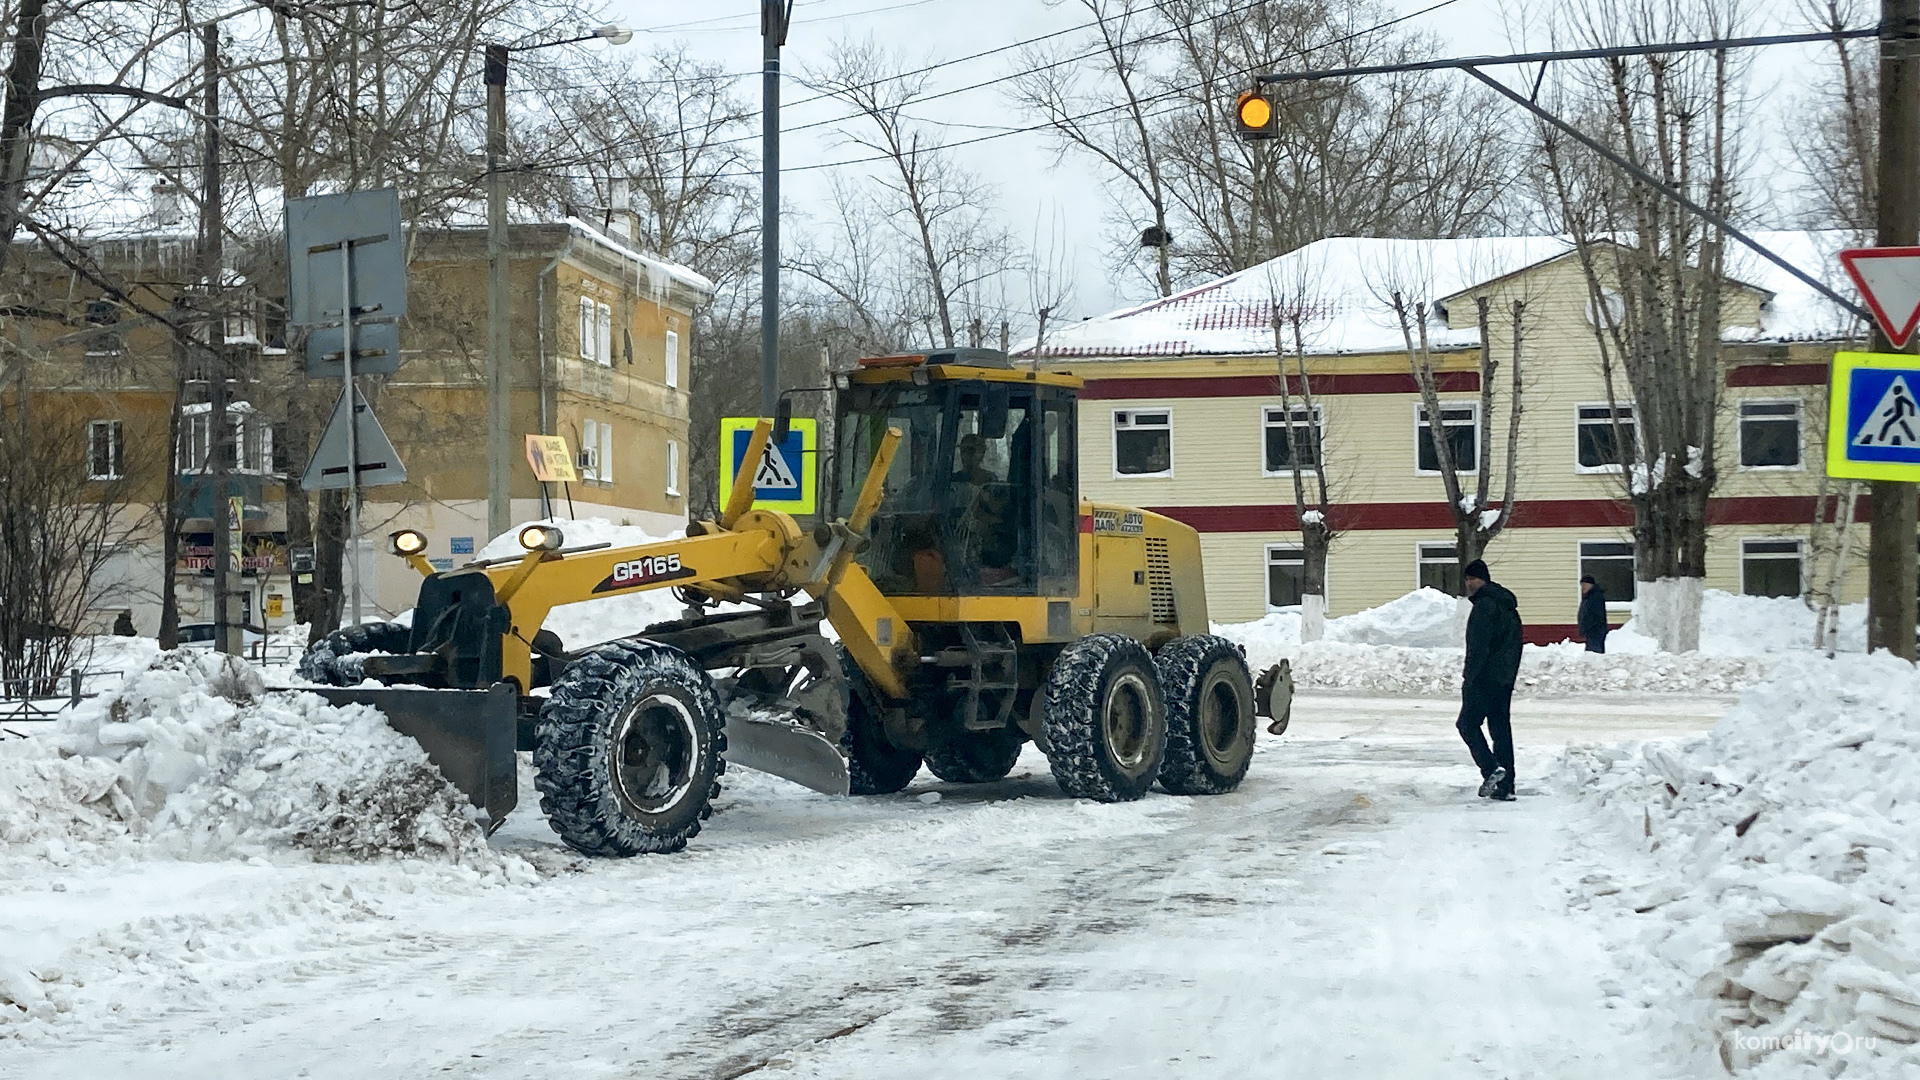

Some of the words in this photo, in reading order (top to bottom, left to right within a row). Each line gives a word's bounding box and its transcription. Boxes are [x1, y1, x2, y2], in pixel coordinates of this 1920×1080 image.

[1094, 519, 1116, 532] ДАЛЬ
[1123, 512, 1143, 525] АВТО
[613, 553, 682, 582] GR165
